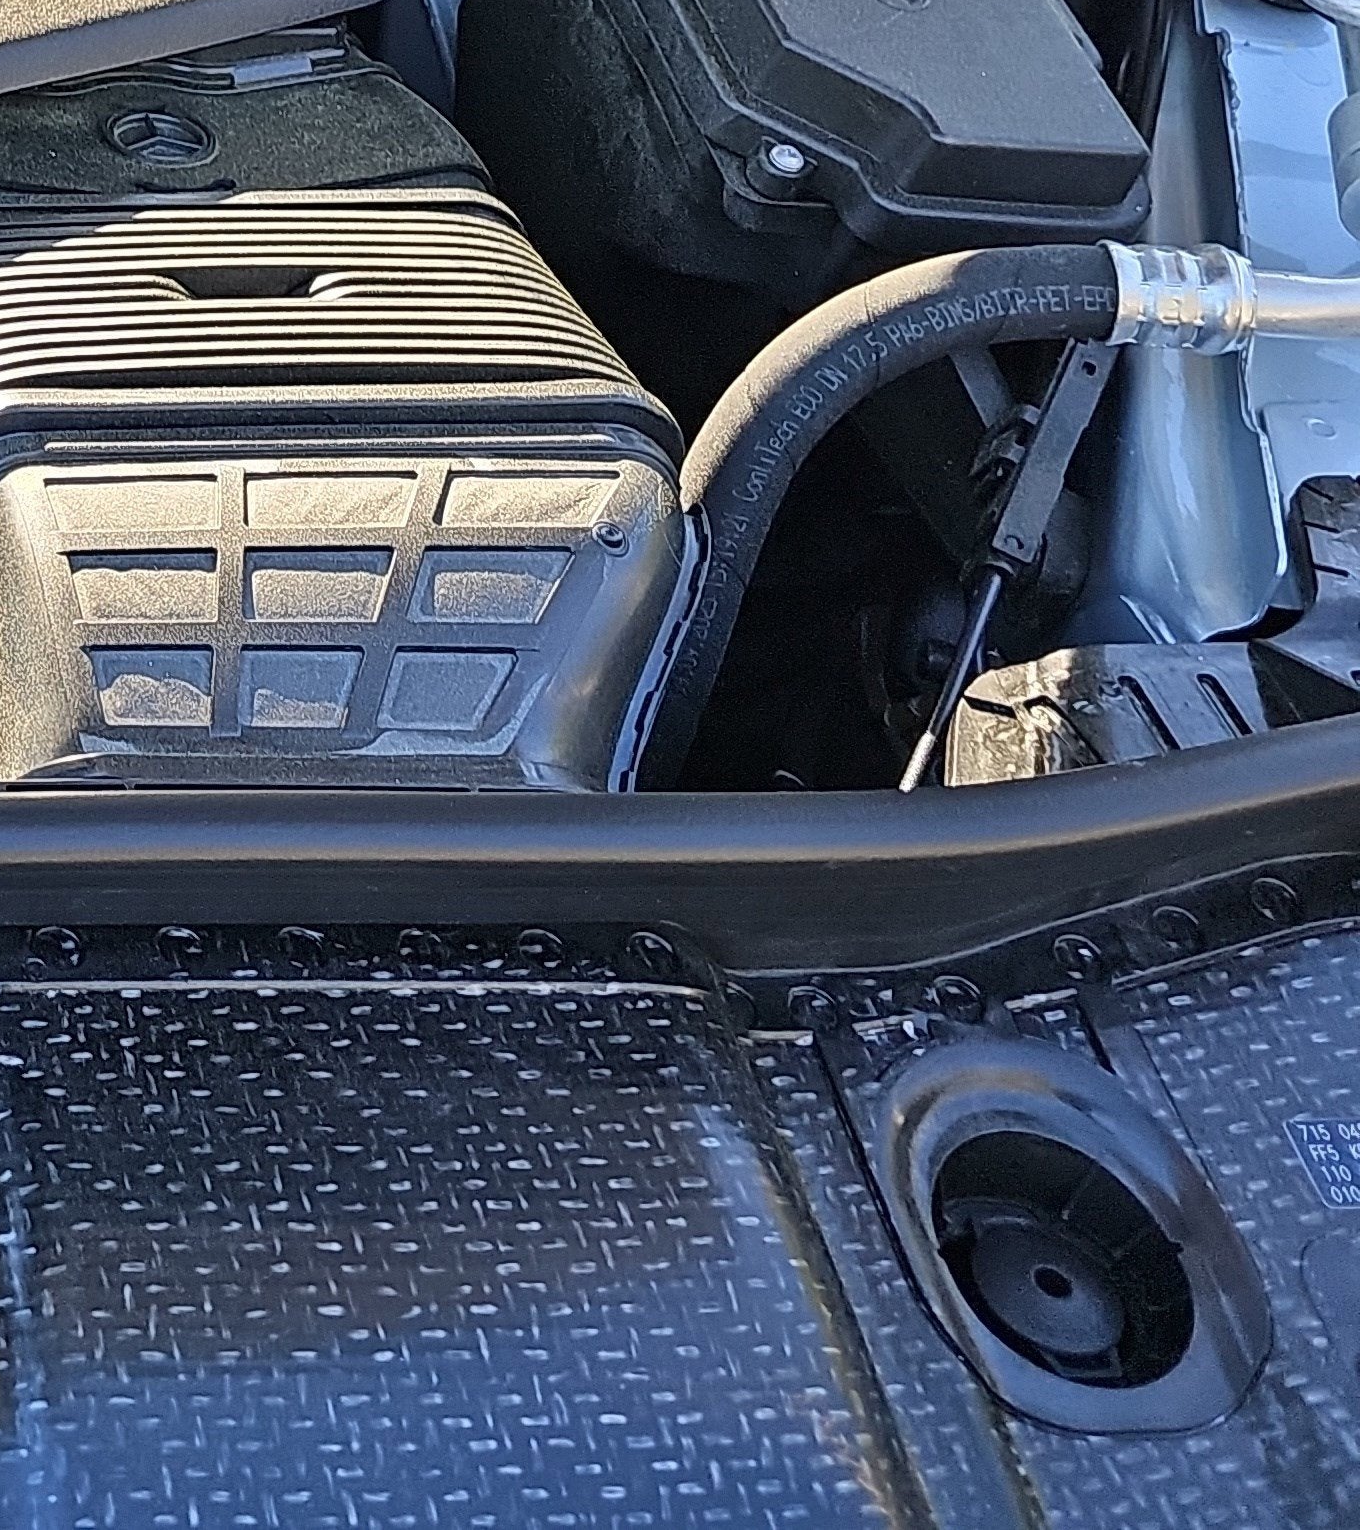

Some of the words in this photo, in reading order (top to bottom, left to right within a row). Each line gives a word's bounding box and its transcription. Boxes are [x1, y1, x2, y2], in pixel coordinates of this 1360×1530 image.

[815, 362, 848, 391] DN
[841, 331, 888, 372] 17,5
[1296, 1123, 1331, 1142] 715
[1308, 1143, 1340, 1162] FF5
[1321, 1164, 1352, 1183] 110
[1330, 1185, 1360, 1204] 010
